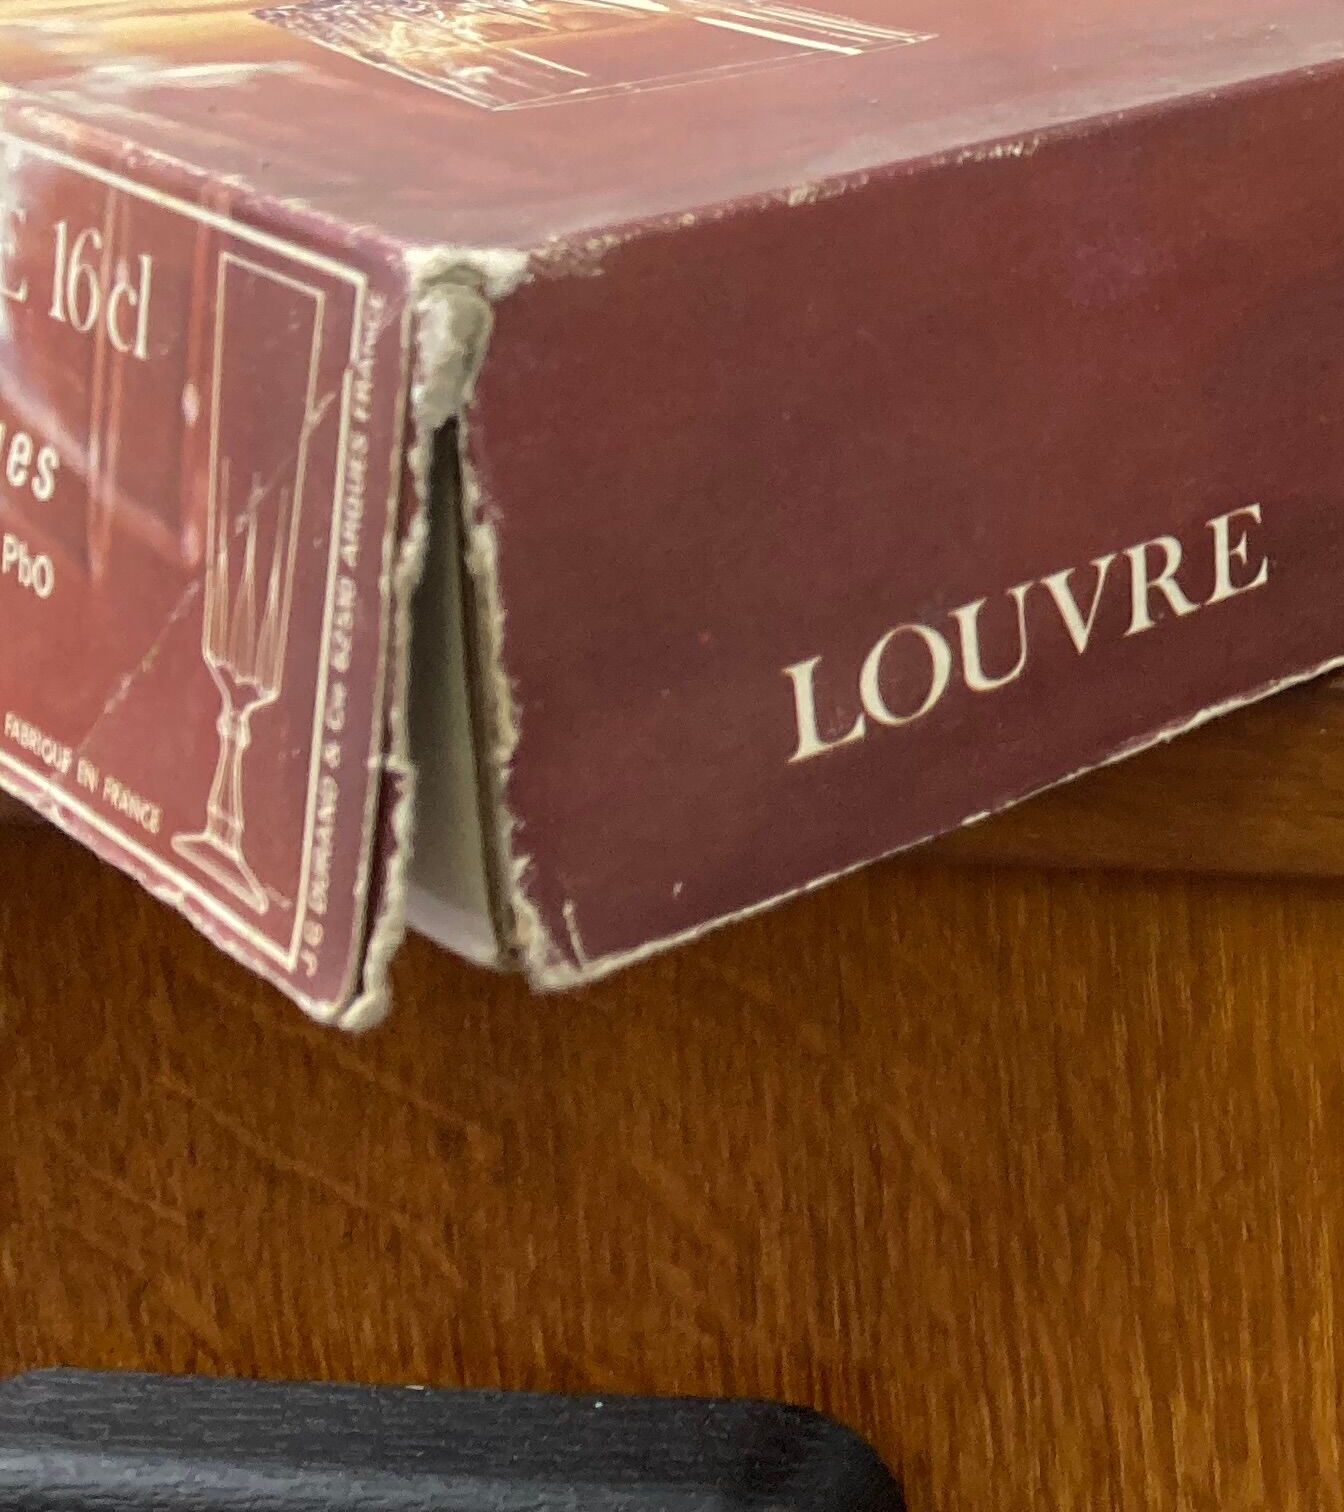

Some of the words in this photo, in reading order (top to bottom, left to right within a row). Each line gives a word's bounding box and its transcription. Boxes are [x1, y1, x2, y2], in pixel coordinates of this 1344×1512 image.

[782, 503, 1269, 763] LOUVRE
[77, 756, 100, 794] EN
[103, 775, 163, 835] FRANCE
